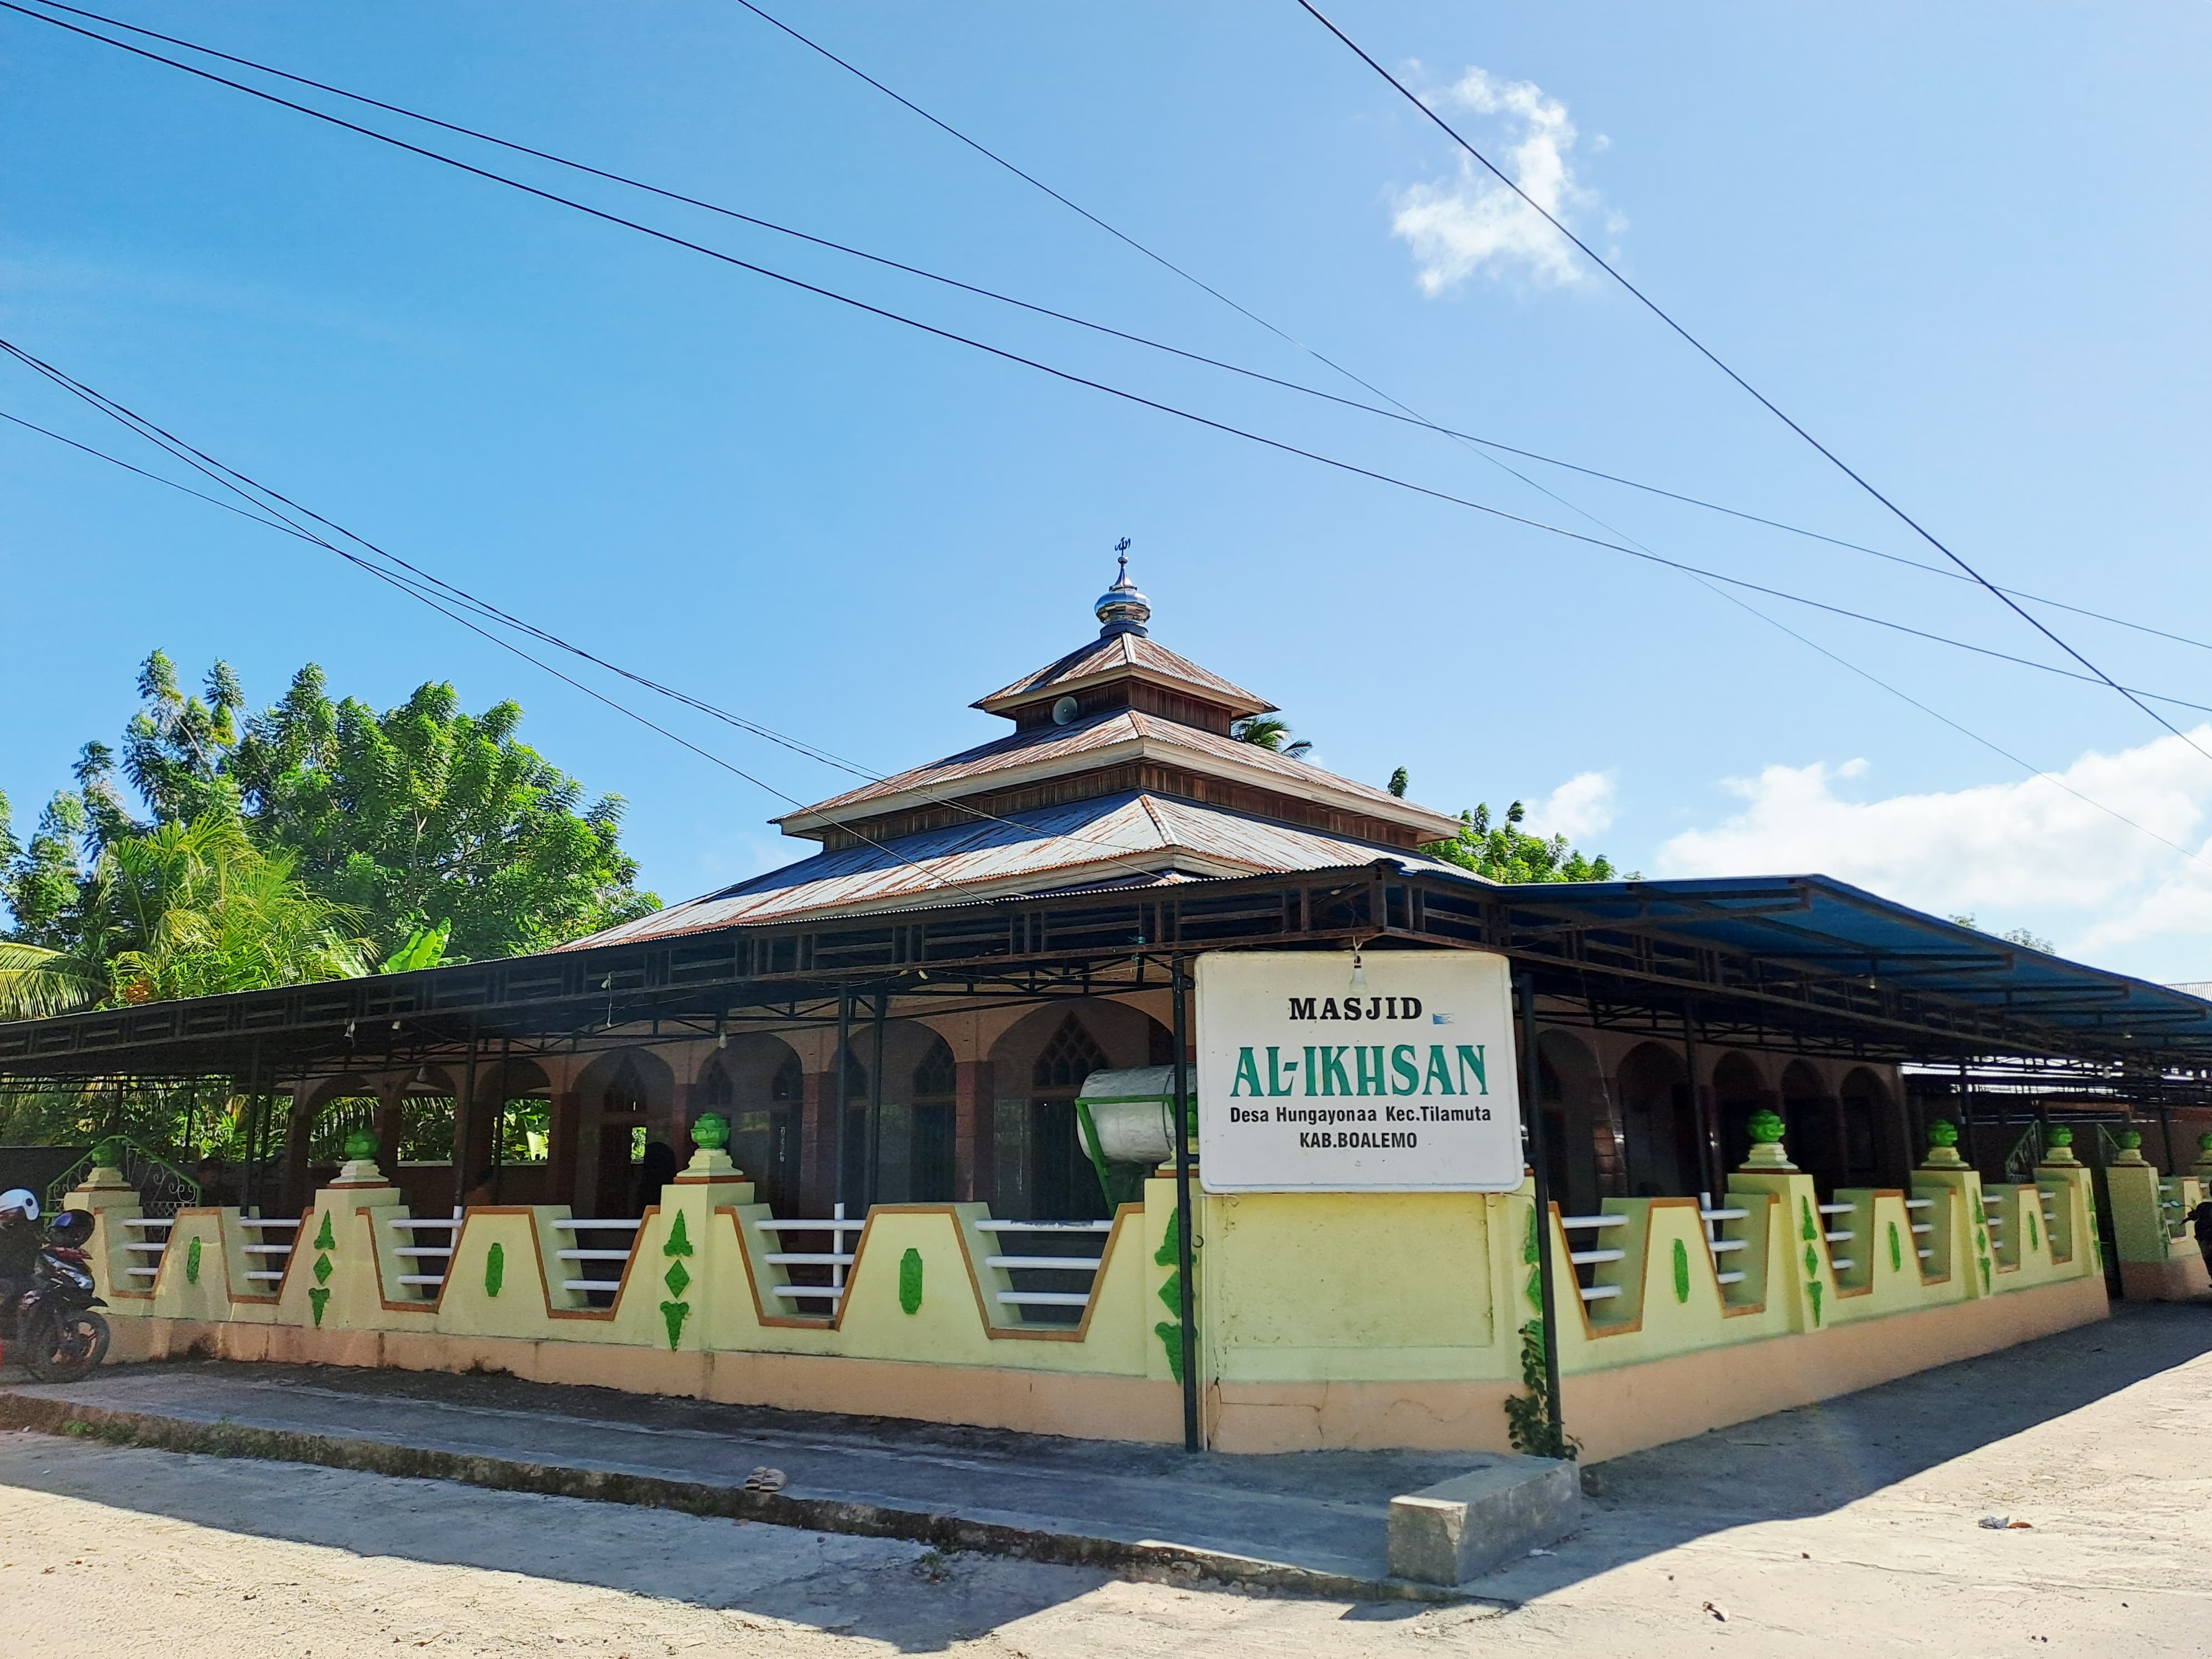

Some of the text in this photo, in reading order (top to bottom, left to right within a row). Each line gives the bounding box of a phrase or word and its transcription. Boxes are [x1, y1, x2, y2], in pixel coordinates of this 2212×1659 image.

[1288, 997, 1422, 1020] MASJID
[1230, 1045, 1489, 1097] AL-IKHSAN
[1230, 1106, 1491, 1125] Desa Hungayonaa Kec.Tilamuta
[1300, 1132, 1417, 1149] KAB.BOALEMO
